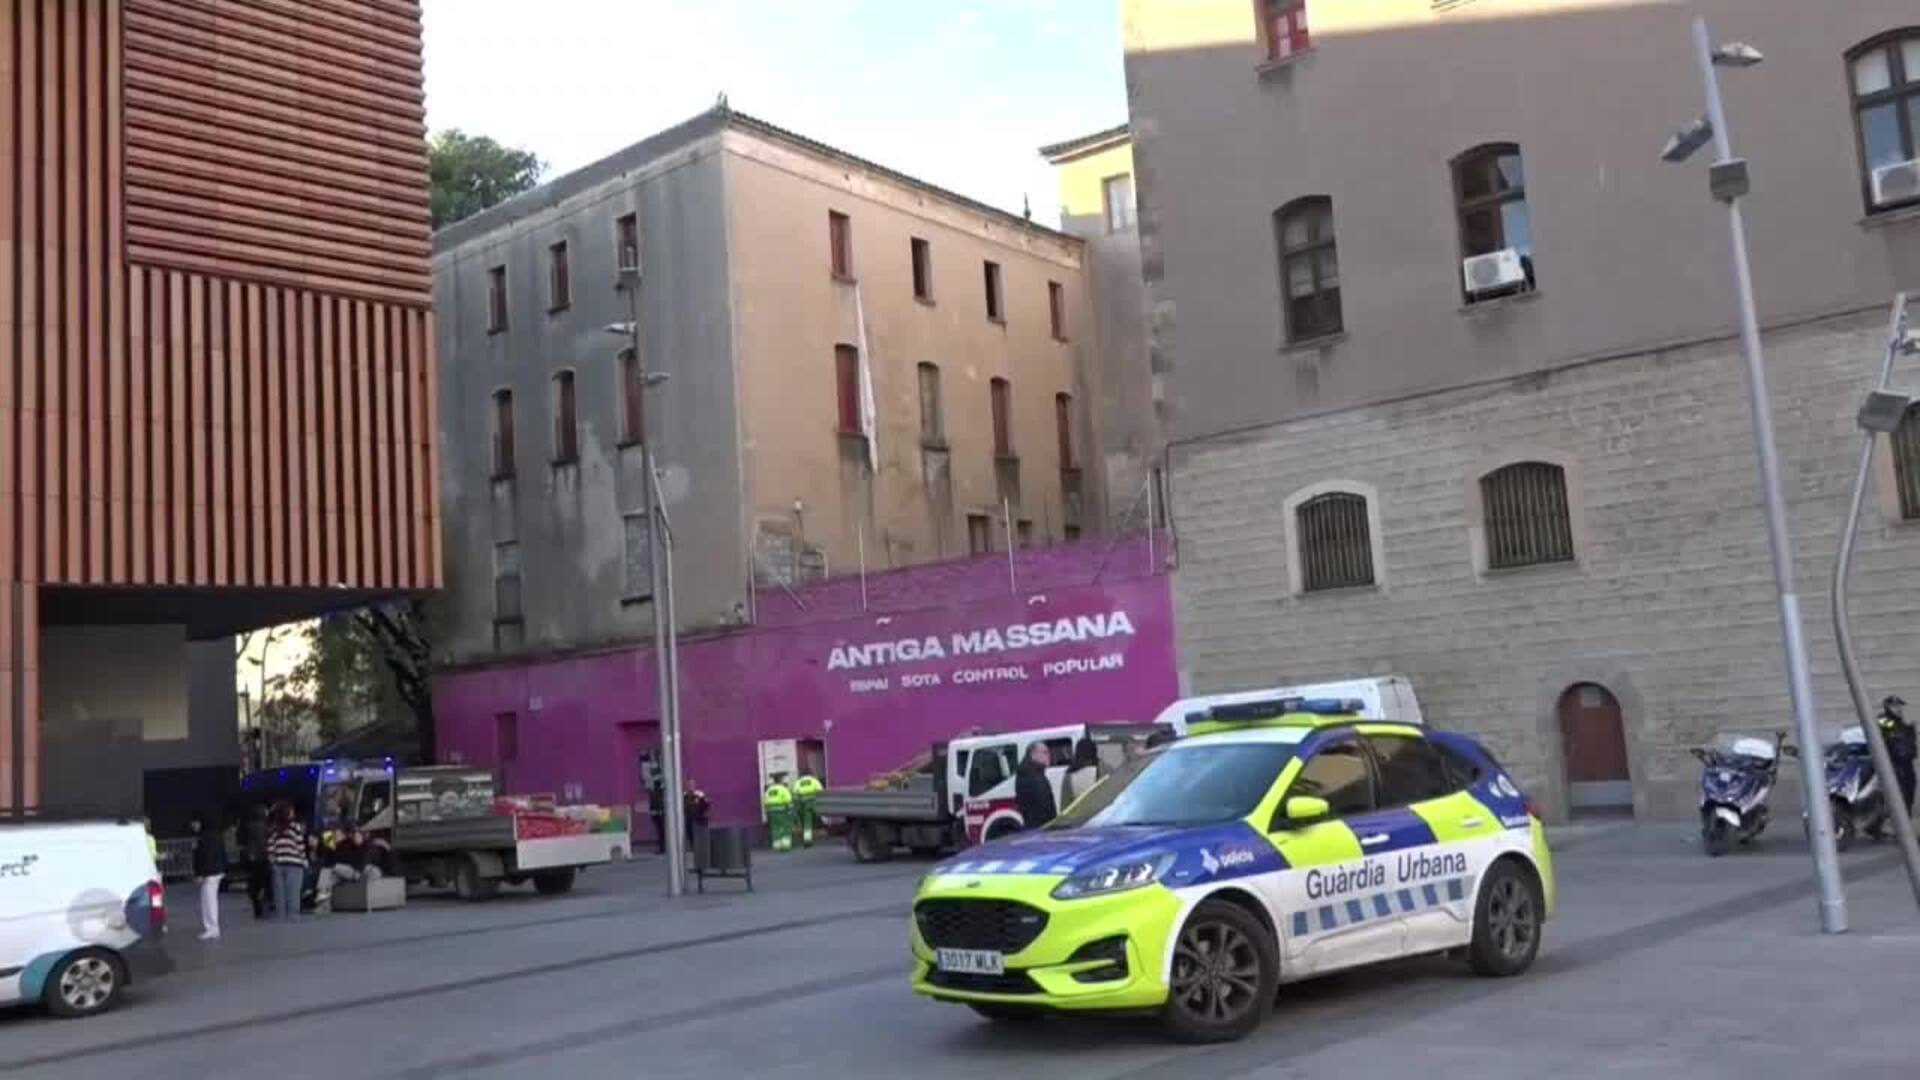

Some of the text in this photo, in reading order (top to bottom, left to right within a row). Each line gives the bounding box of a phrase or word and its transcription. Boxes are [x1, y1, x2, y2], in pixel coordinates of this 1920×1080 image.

[952, 610, 1135, 655] MASSANA
[901, 673, 941, 688] SOTA
[953, 665, 1028, 685] CONTROL
[1043, 653, 1123, 677] POPULAR
[1306, 852, 1467, 900] Guàrdia Urbana
